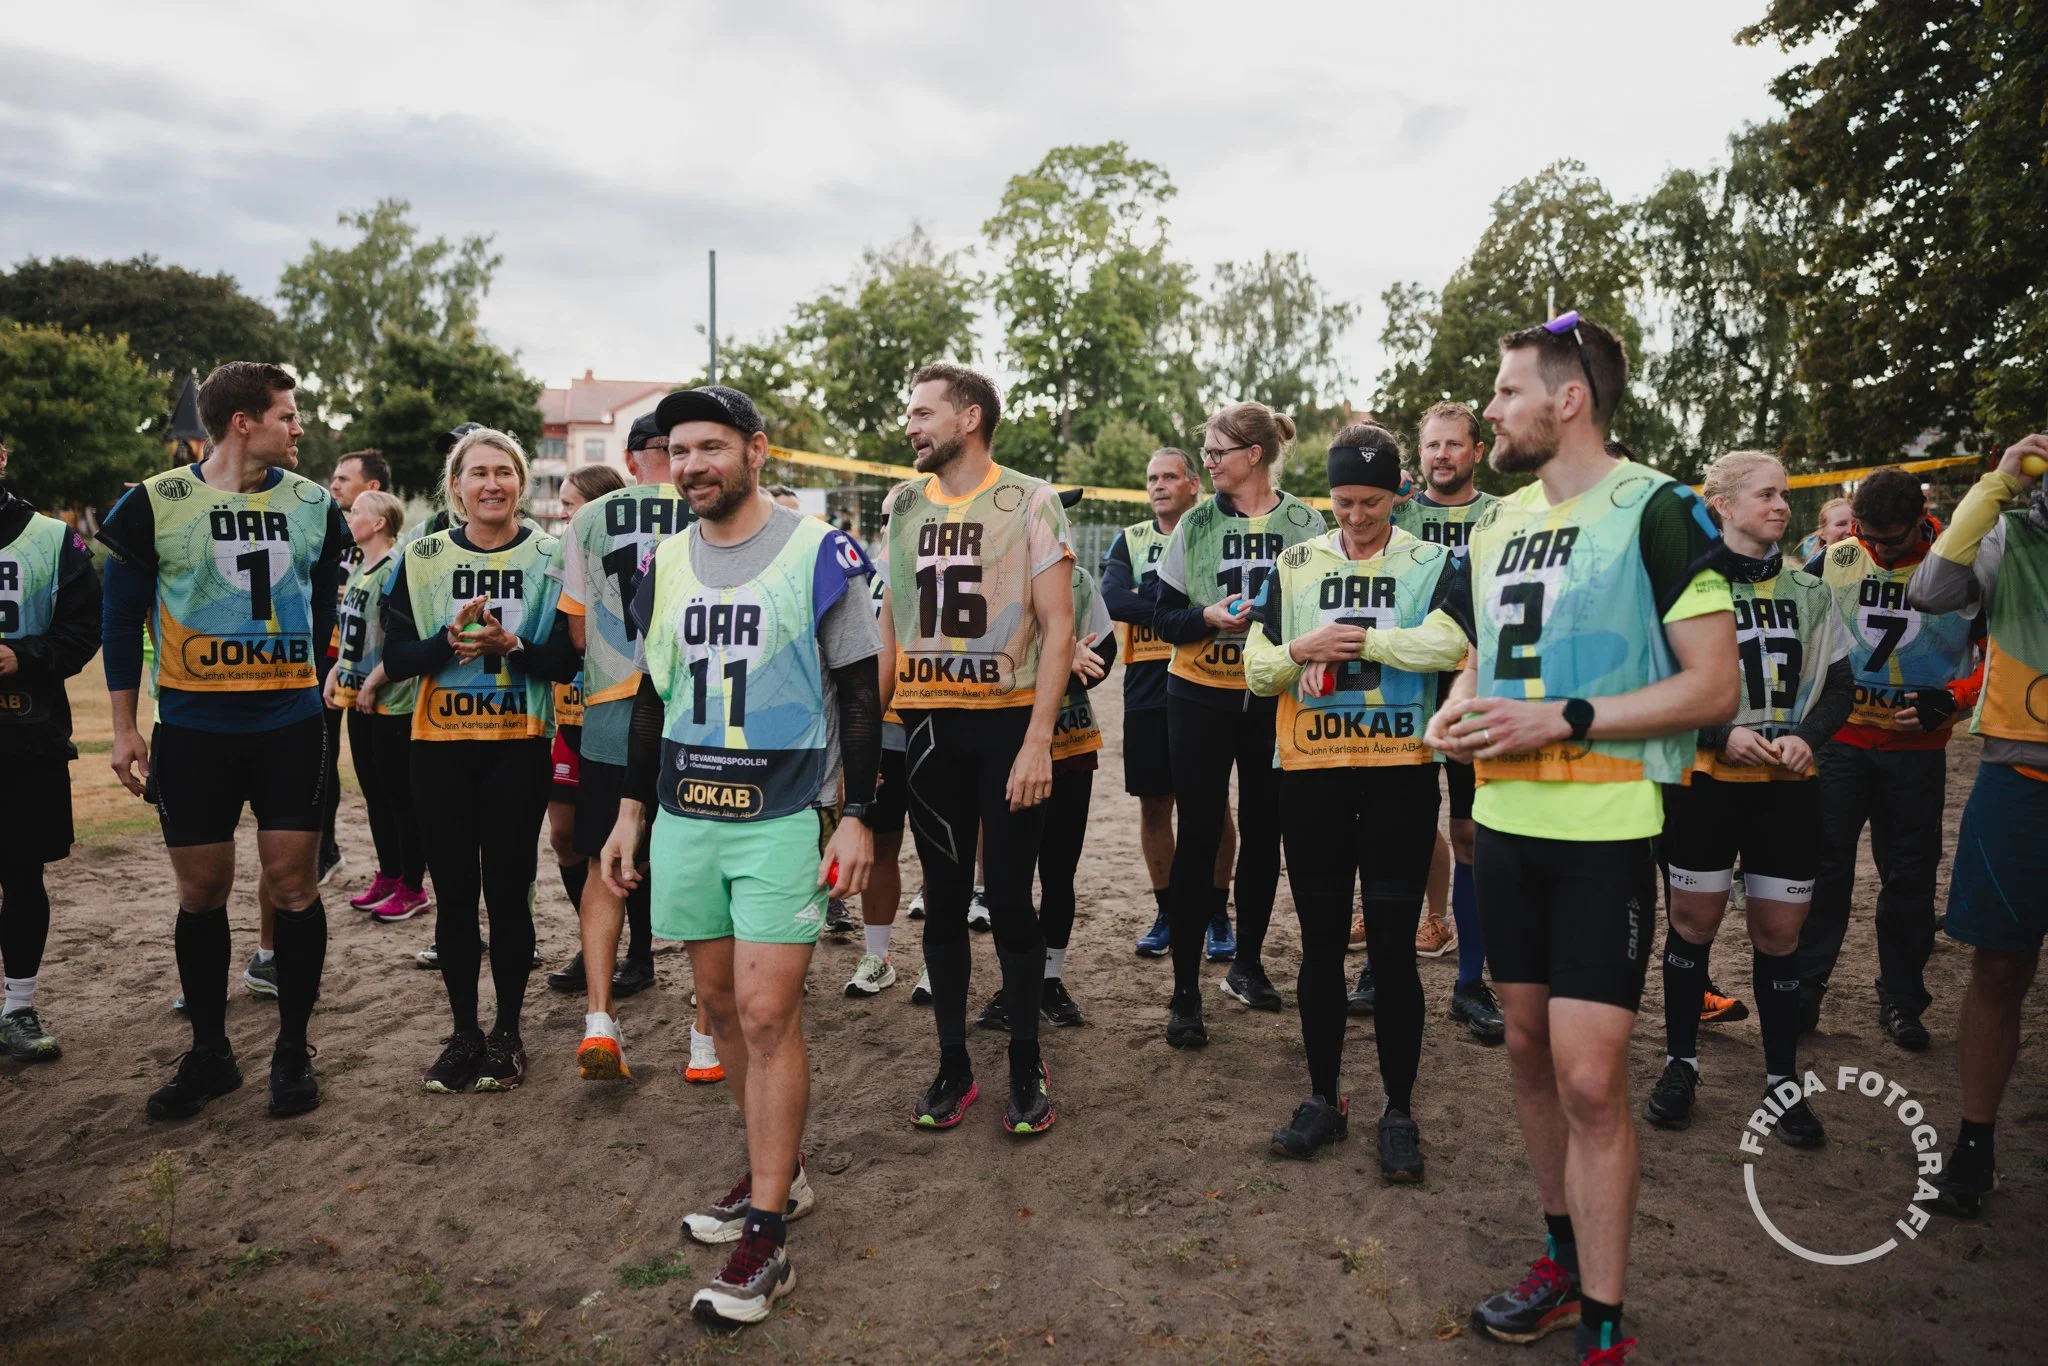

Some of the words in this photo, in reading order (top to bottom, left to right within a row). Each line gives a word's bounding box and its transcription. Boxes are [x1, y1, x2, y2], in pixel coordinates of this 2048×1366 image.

[210, 504, 290, 541] ÖAR
[918, 518, 983, 556] ÖAR
[1223, 529, 1283, 560] ÖAR
[1496, 529, 1580, 576] ÖAR
[236, 548, 272, 620] 1
[453, 564, 523, 599] ÖAR
[602, 542, 638, 642] 1
[1320, 572, 1396, 610] ÖAR
[1859, 575, 1911, 610] ÖA
[916, 565, 987, 638] 16
[684, 597, 761, 646] ÖAR
[1494, 581, 1545, 680] 2
[200, 640, 309, 665] JOKAB
[1864, 614, 1908, 672] 7
[202, 672, 225, 680] John
[228, 670, 271, 679] Karlsson
[274, 668, 293, 678] Åkeri
[899, 658, 1000, 683] JOKAB
[1740, 636, 1803, 710] 13
[689, 657, 748, 727] 11
[899, 689, 917, 697] John
[920, 688, 959, 697] Karlsson
[962, 687, 985, 697] Åkeri
[988, 688, 1001, 696] AB
[462, 721, 500, 730] Karlsson
[503, 718, 523, 728] Åkeri
[1307, 712, 1415, 740] JOKAB
[689, 753, 768, 766] BEVAKNINGSPOOLEN
[1309, 748, 1327, 756] John
[1329, 744, 1370, 754] Karlsson
[1373, 742, 1399, 753] Åkeri
[1401, 743, 1415, 752] AB
[684, 784, 750, 808] JOKAB
[1786, 886, 1813, 895] CRA
[1628, 910, 1639, 960] CRAFT
